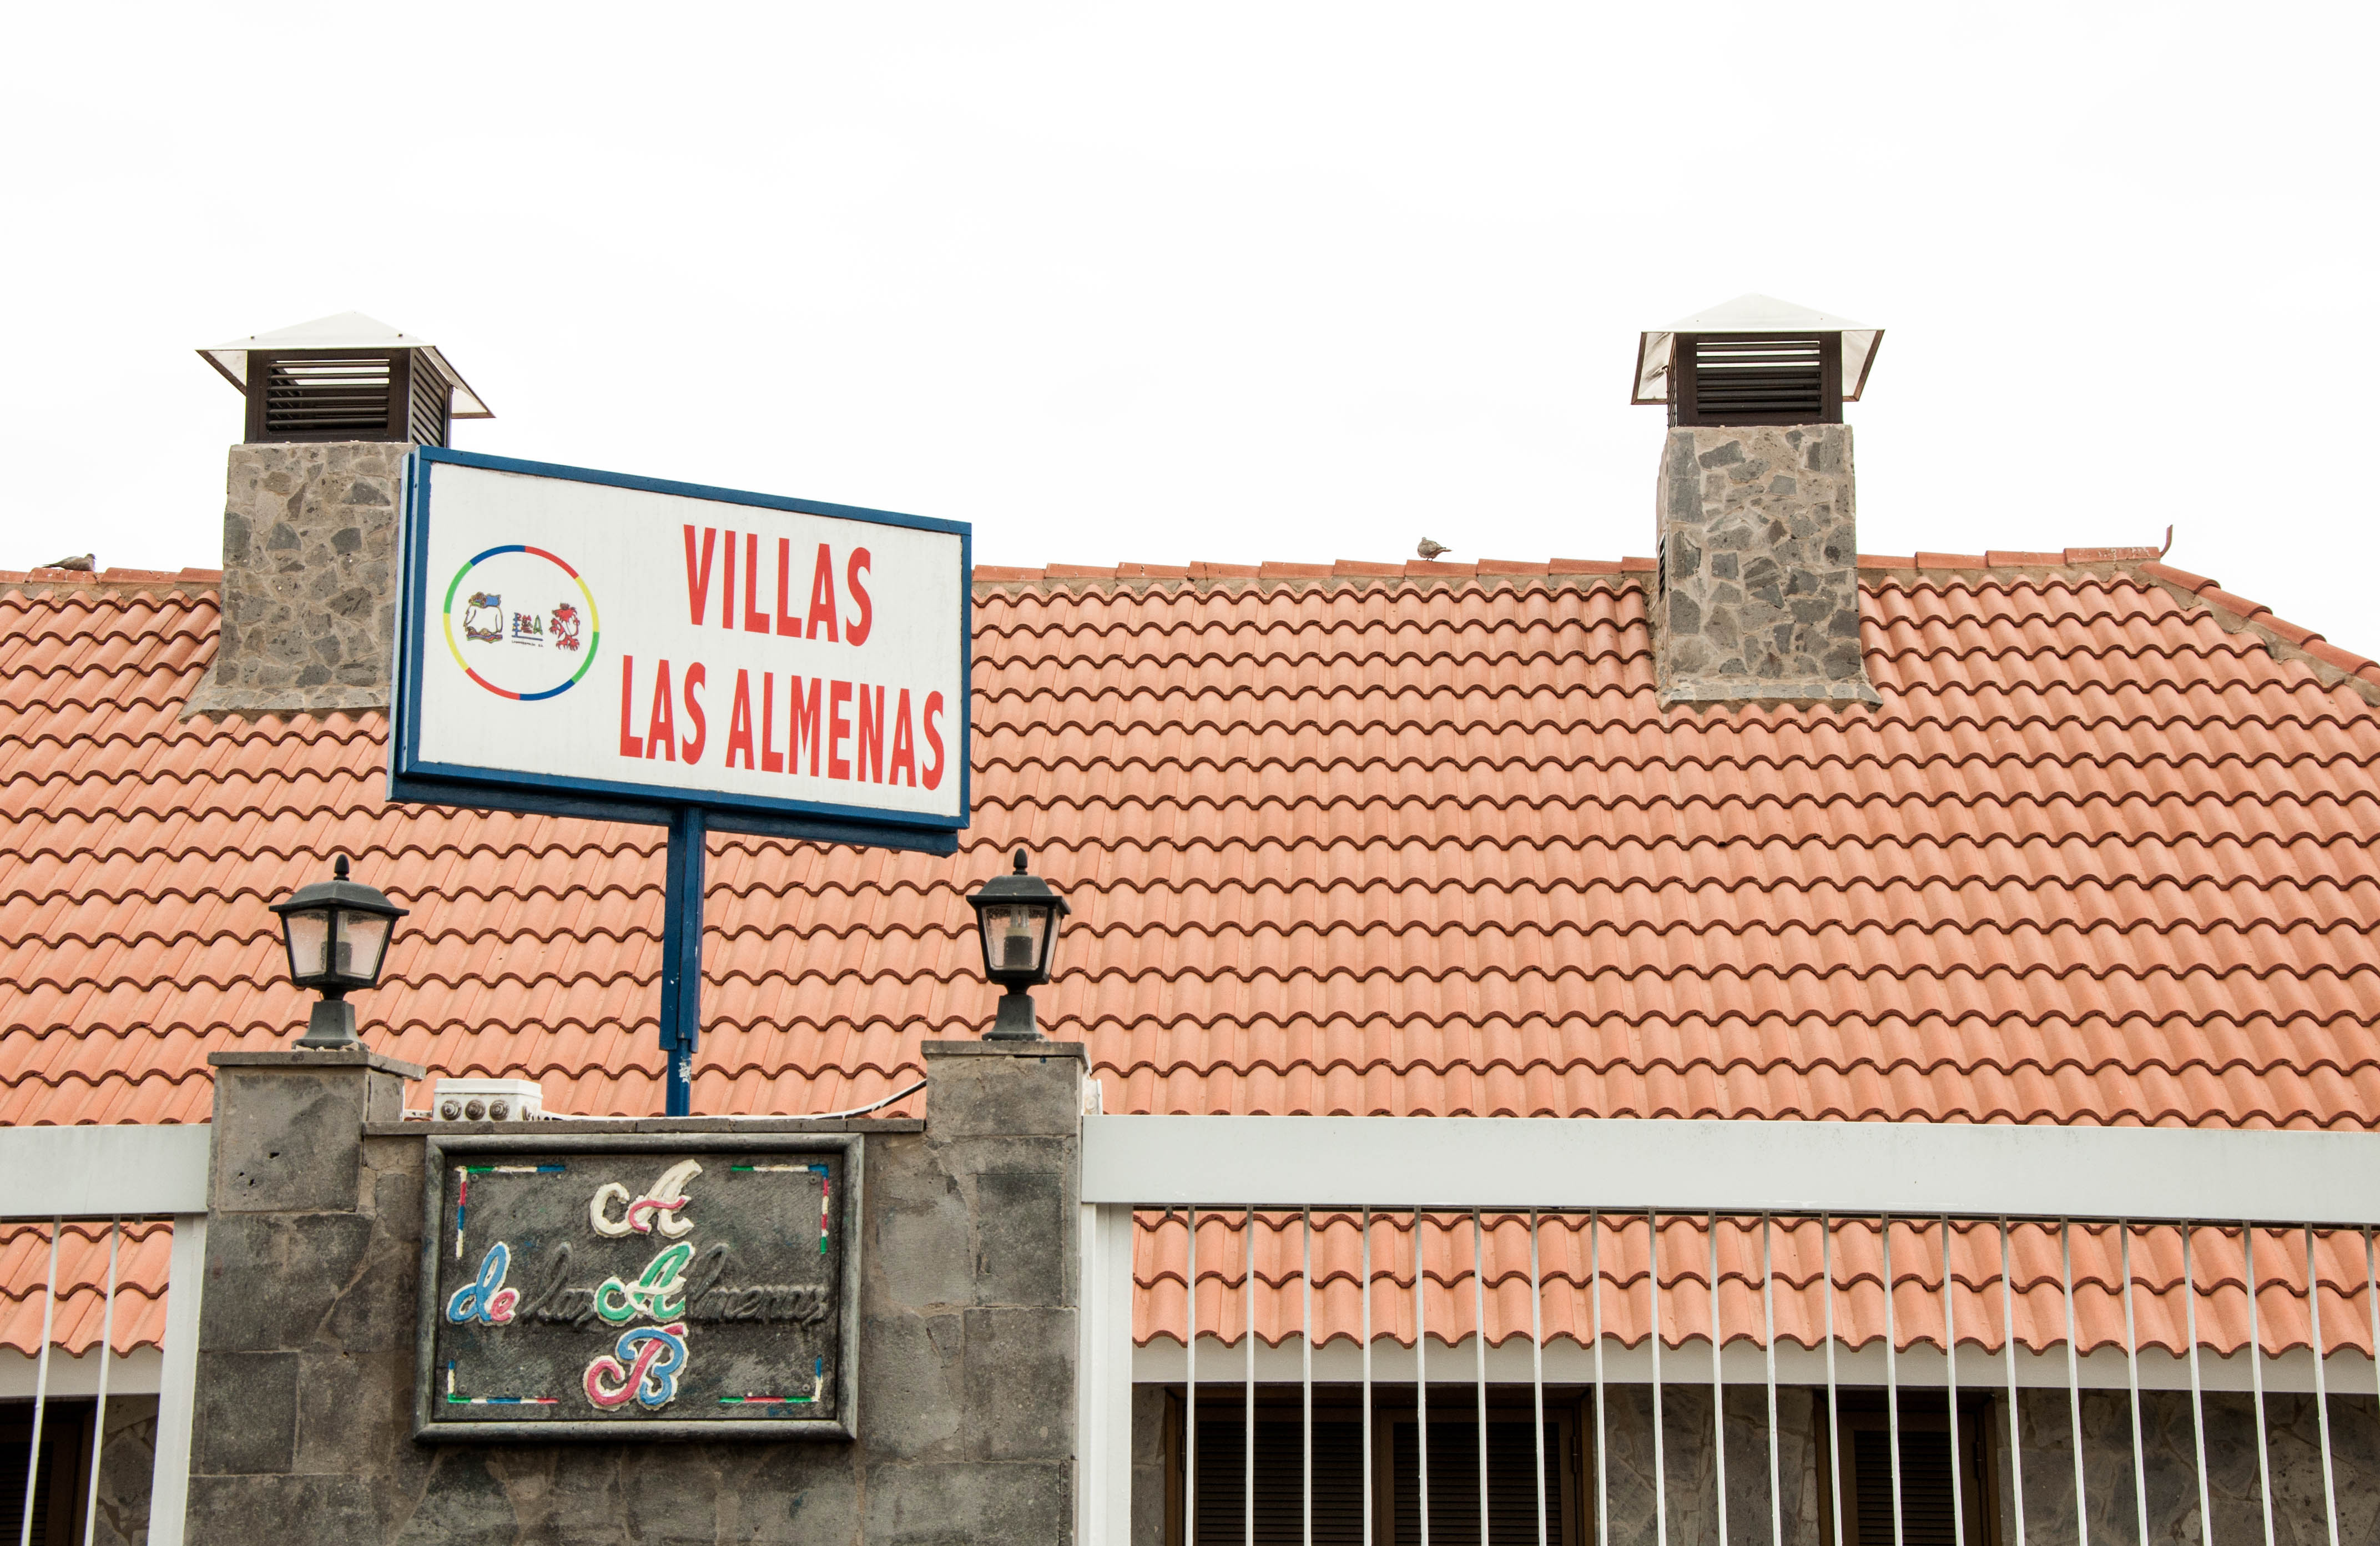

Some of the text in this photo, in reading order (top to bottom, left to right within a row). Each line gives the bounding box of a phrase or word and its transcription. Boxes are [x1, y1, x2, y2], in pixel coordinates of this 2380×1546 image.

[683, 524, 872, 647] VILLAS
[619, 654, 945, 791] LAS ALMENAS
[446, 1241, 521, 1326] de
[521, 1241, 596, 1327] las
